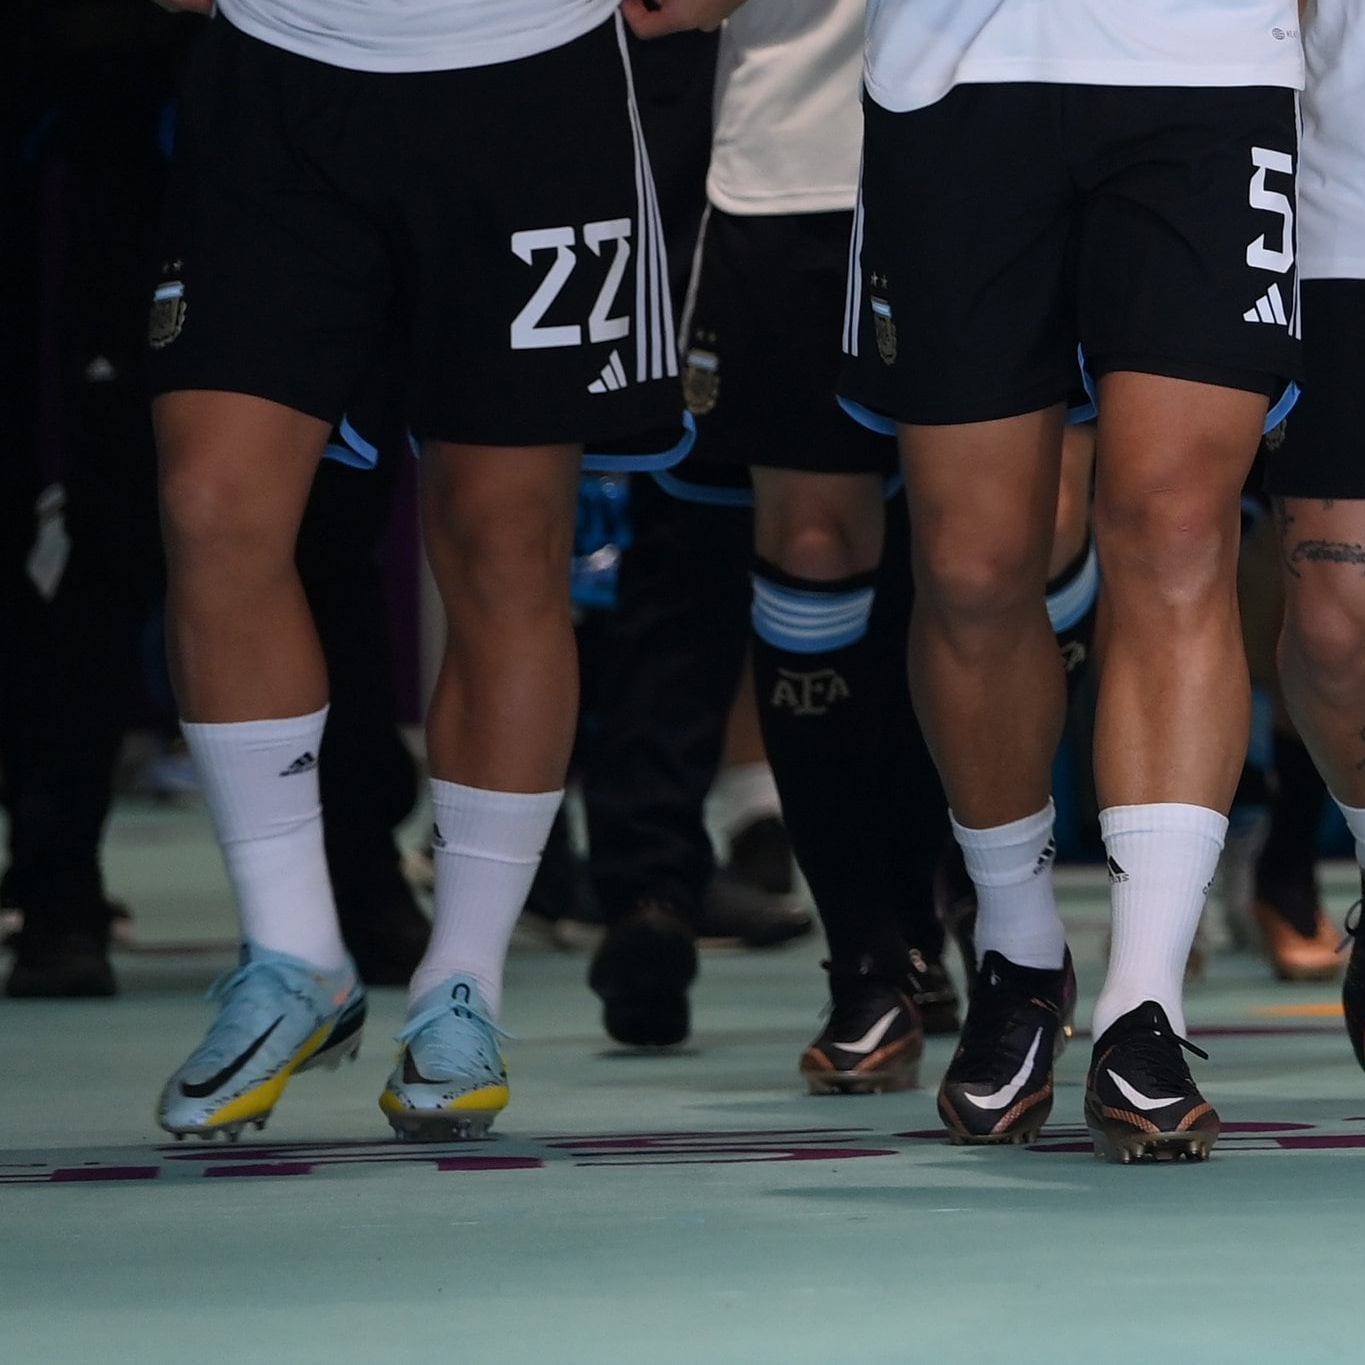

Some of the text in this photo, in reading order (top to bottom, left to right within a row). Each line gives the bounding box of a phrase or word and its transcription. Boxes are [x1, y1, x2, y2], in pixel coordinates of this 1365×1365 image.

[1246, 146, 1293, 274] 5
[510, 217, 632, 350] 22
[769, 667, 850, 716] AFA
